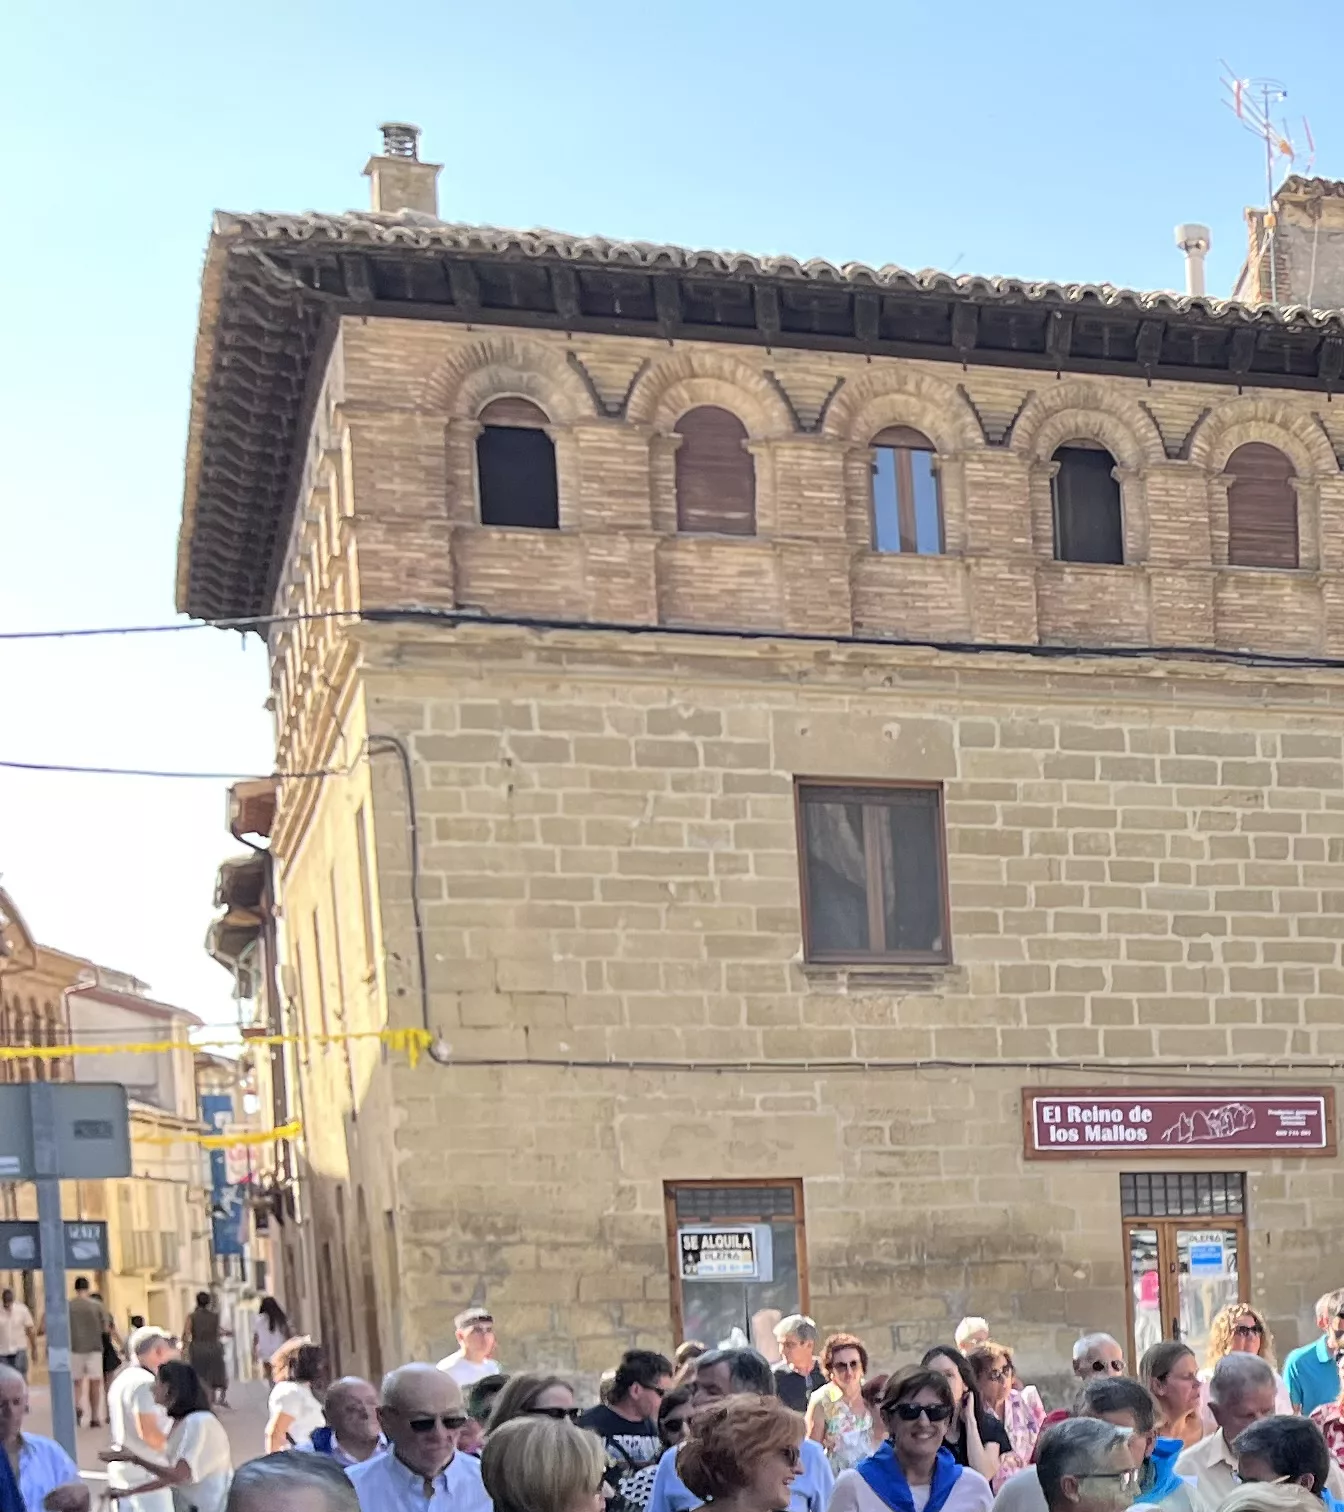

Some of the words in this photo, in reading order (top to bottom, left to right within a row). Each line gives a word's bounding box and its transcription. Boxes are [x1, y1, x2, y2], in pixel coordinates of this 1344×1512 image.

[1043, 1105, 1061, 1122] El
[1067, 1105, 1123, 1122] Reino
[1129, 1105, 1152, 1122] de
[1050, 1125, 1079, 1142] los
[1085, 1125, 1148, 1142] Mallos
[683, 1235, 699, 1250] SE
[702, 1234, 751, 1249] ALQUILA
